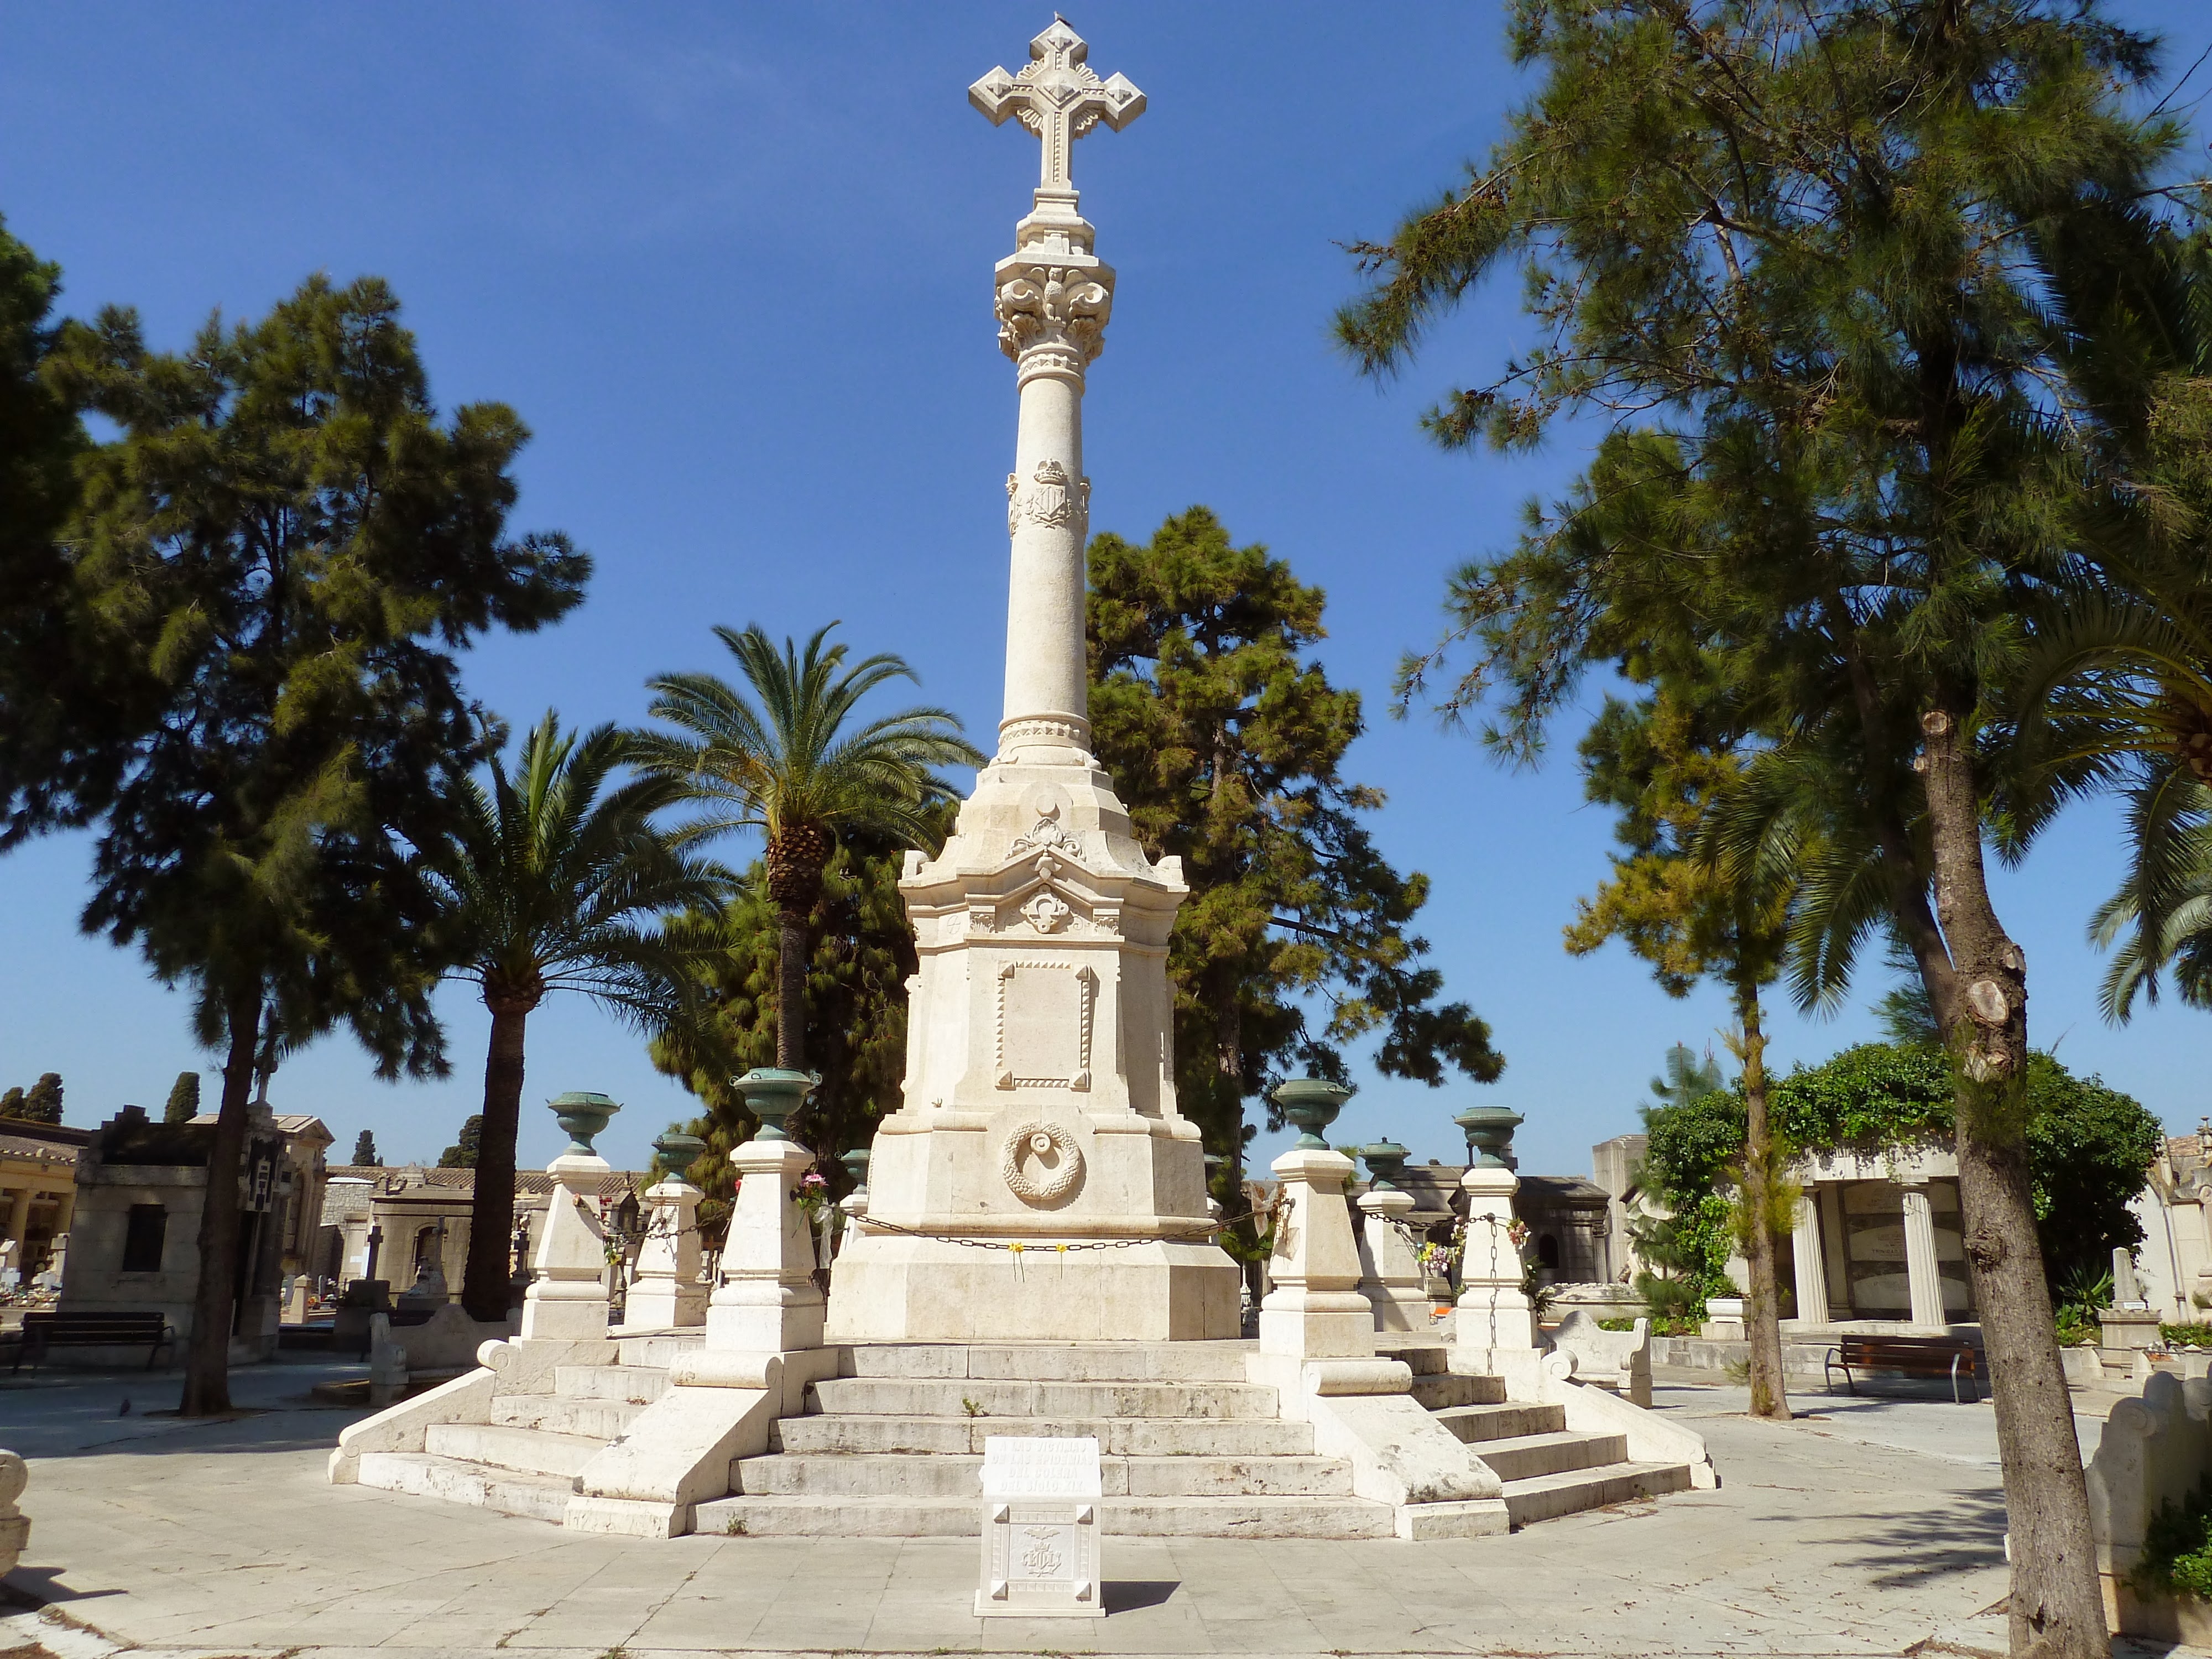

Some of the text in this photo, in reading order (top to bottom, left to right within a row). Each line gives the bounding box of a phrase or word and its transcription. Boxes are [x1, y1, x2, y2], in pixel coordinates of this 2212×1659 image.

[1013, 1442, 1031, 1452] LAS
[1035, 1442, 1087, 1452] VICTIMAS
[992, 1453, 1094, 1465] DE LAS EPIDEMIAS
[1009, 1467, 1029, 1478] DEL
[1000, 1480, 1021, 1491] DEL
[1026, 1480, 1059, 1491] SIGLO
